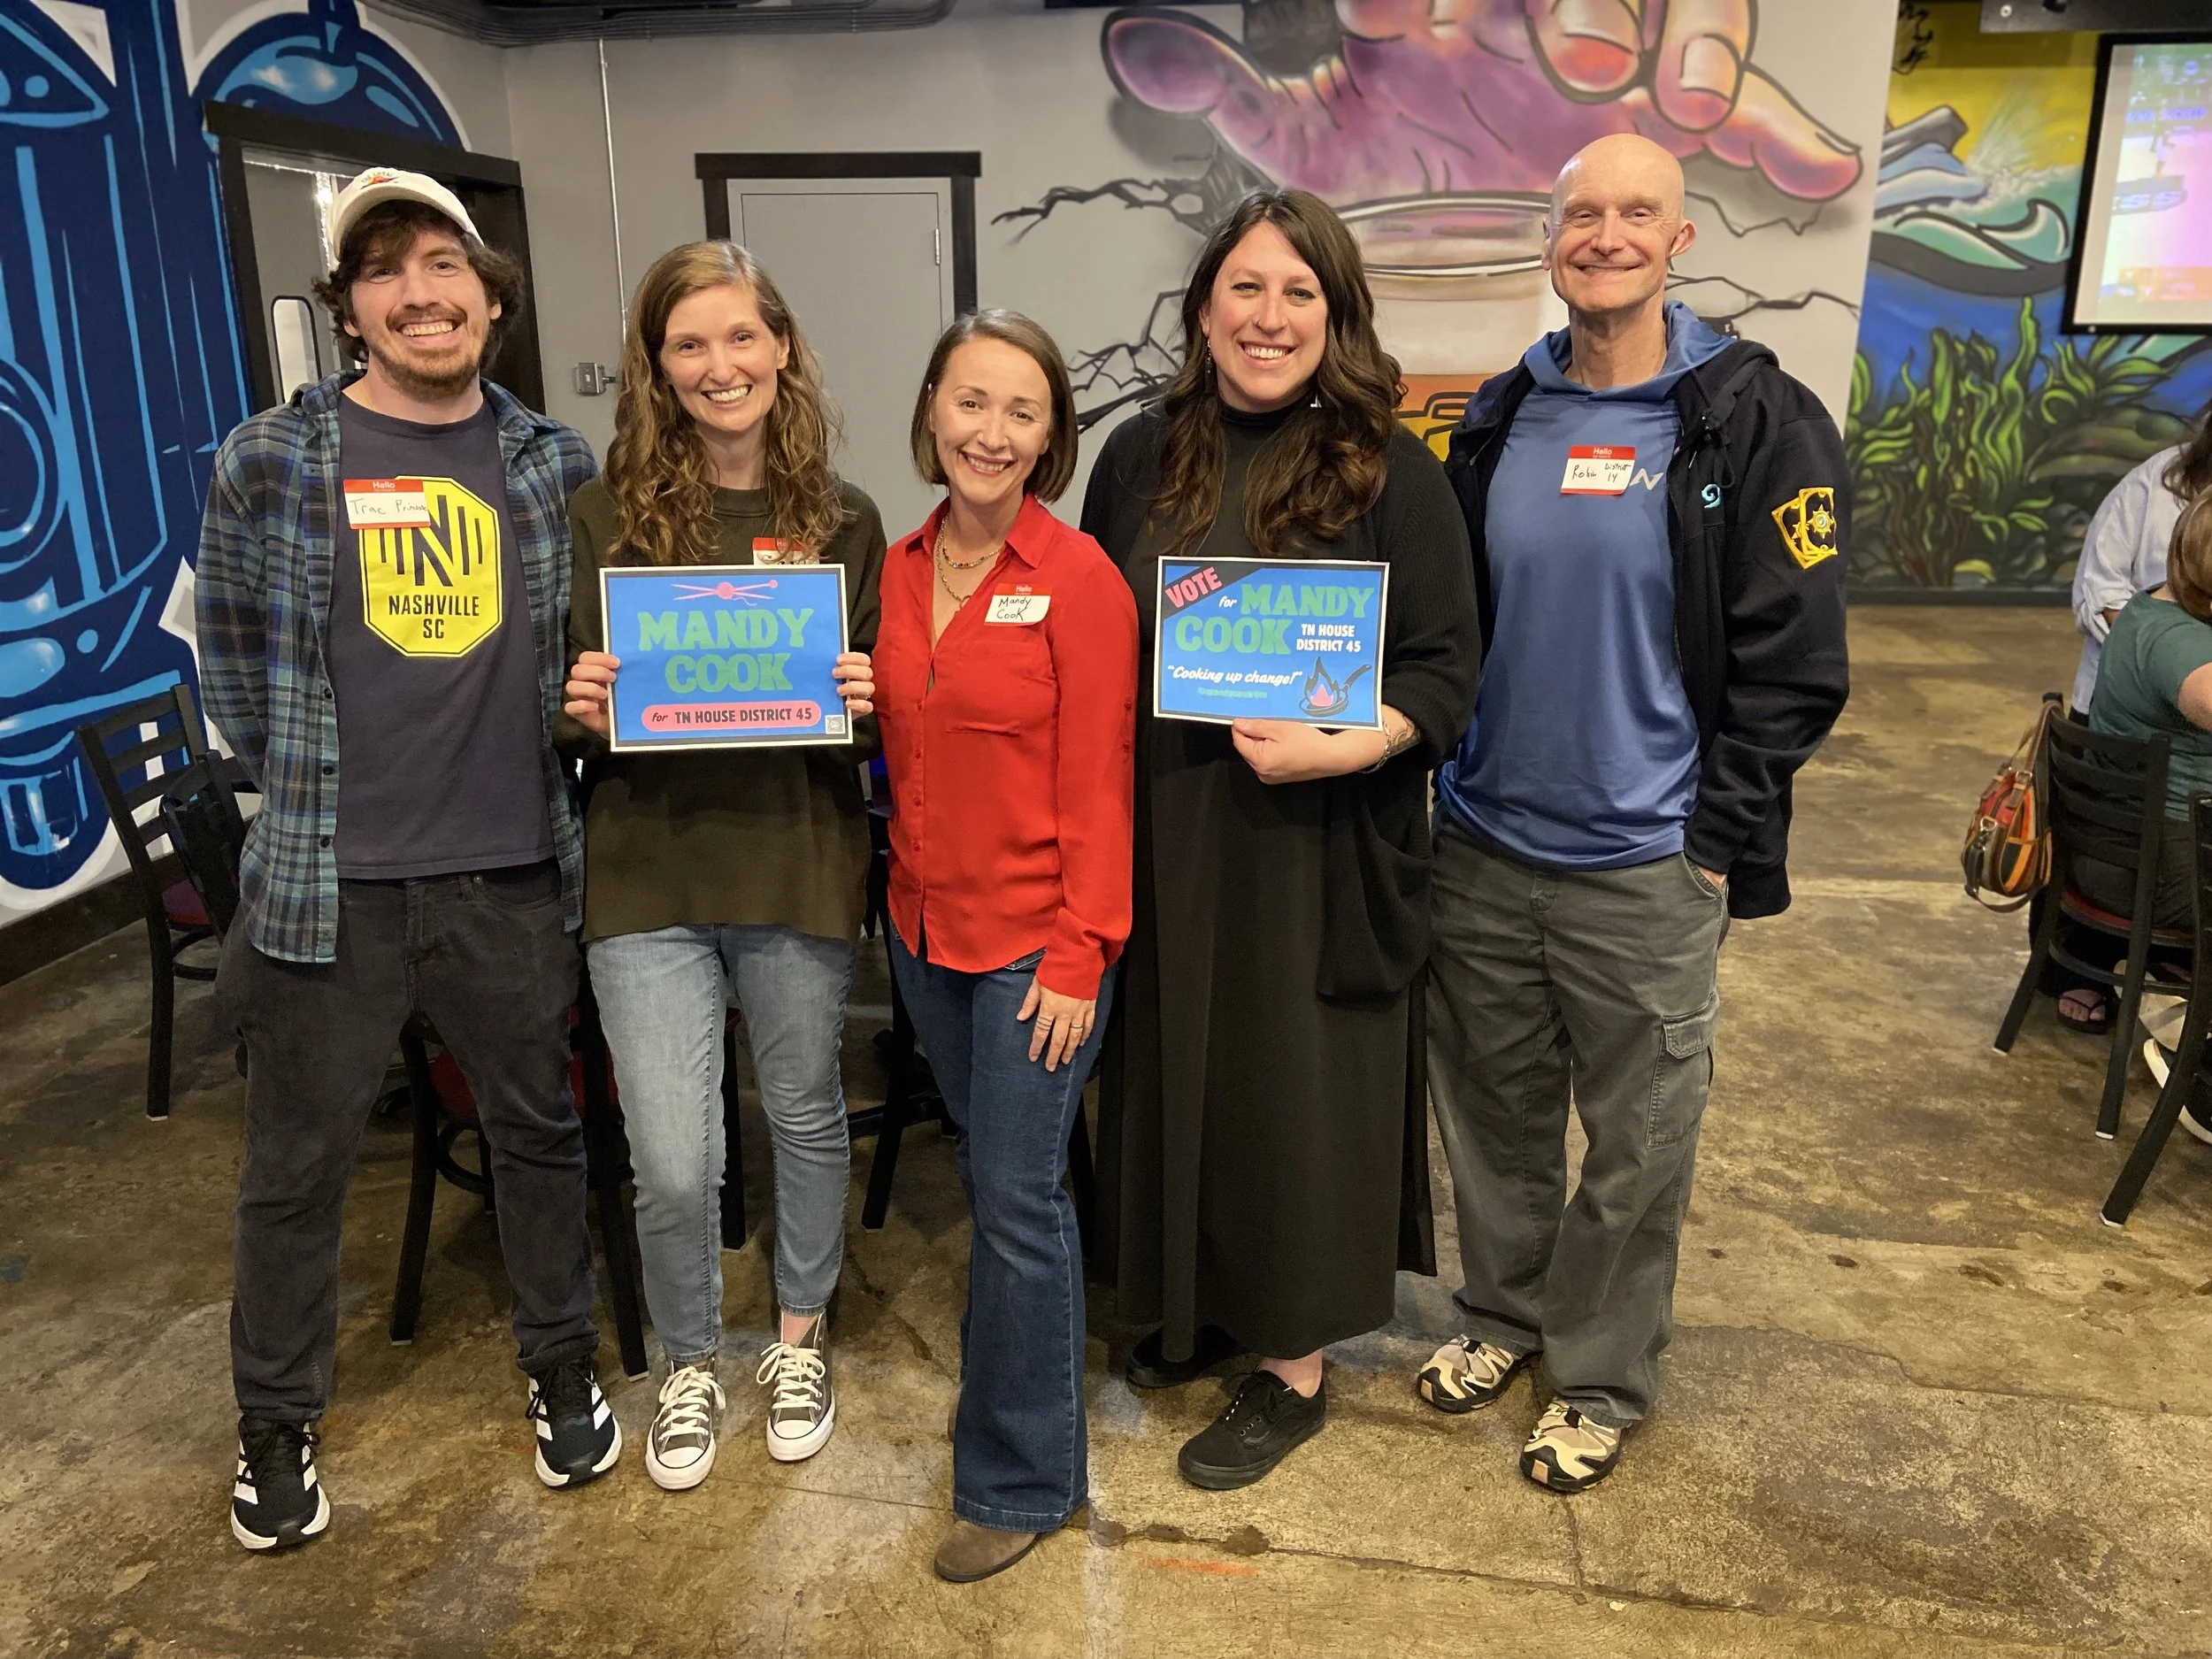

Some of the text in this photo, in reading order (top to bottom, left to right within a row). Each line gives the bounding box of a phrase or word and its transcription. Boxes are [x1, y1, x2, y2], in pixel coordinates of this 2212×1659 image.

[373, 480, 396, 489] Hello
[1164, 566, 1223, 609] VOTE
[388, 595, 480, 617] NASHVILLE
[998, 596, 1032, 609] Mandy
[1218, 583, 1374, 618] for MANDY
[422, 618, 445, 640] SC
[637, 608, 815, 652] MANDY
[1175, 616, 1292, 655] COOK
[1301, 624, 1355, 638] TN HOUSE
[1296, 640, 1362, 653] DISTRICT 45
[664, 652, 794, 694] COOK
[1225, 670, 1243, 684] up
[651, 707, 812, 724] for TN HOUSE DISTRICT 45
